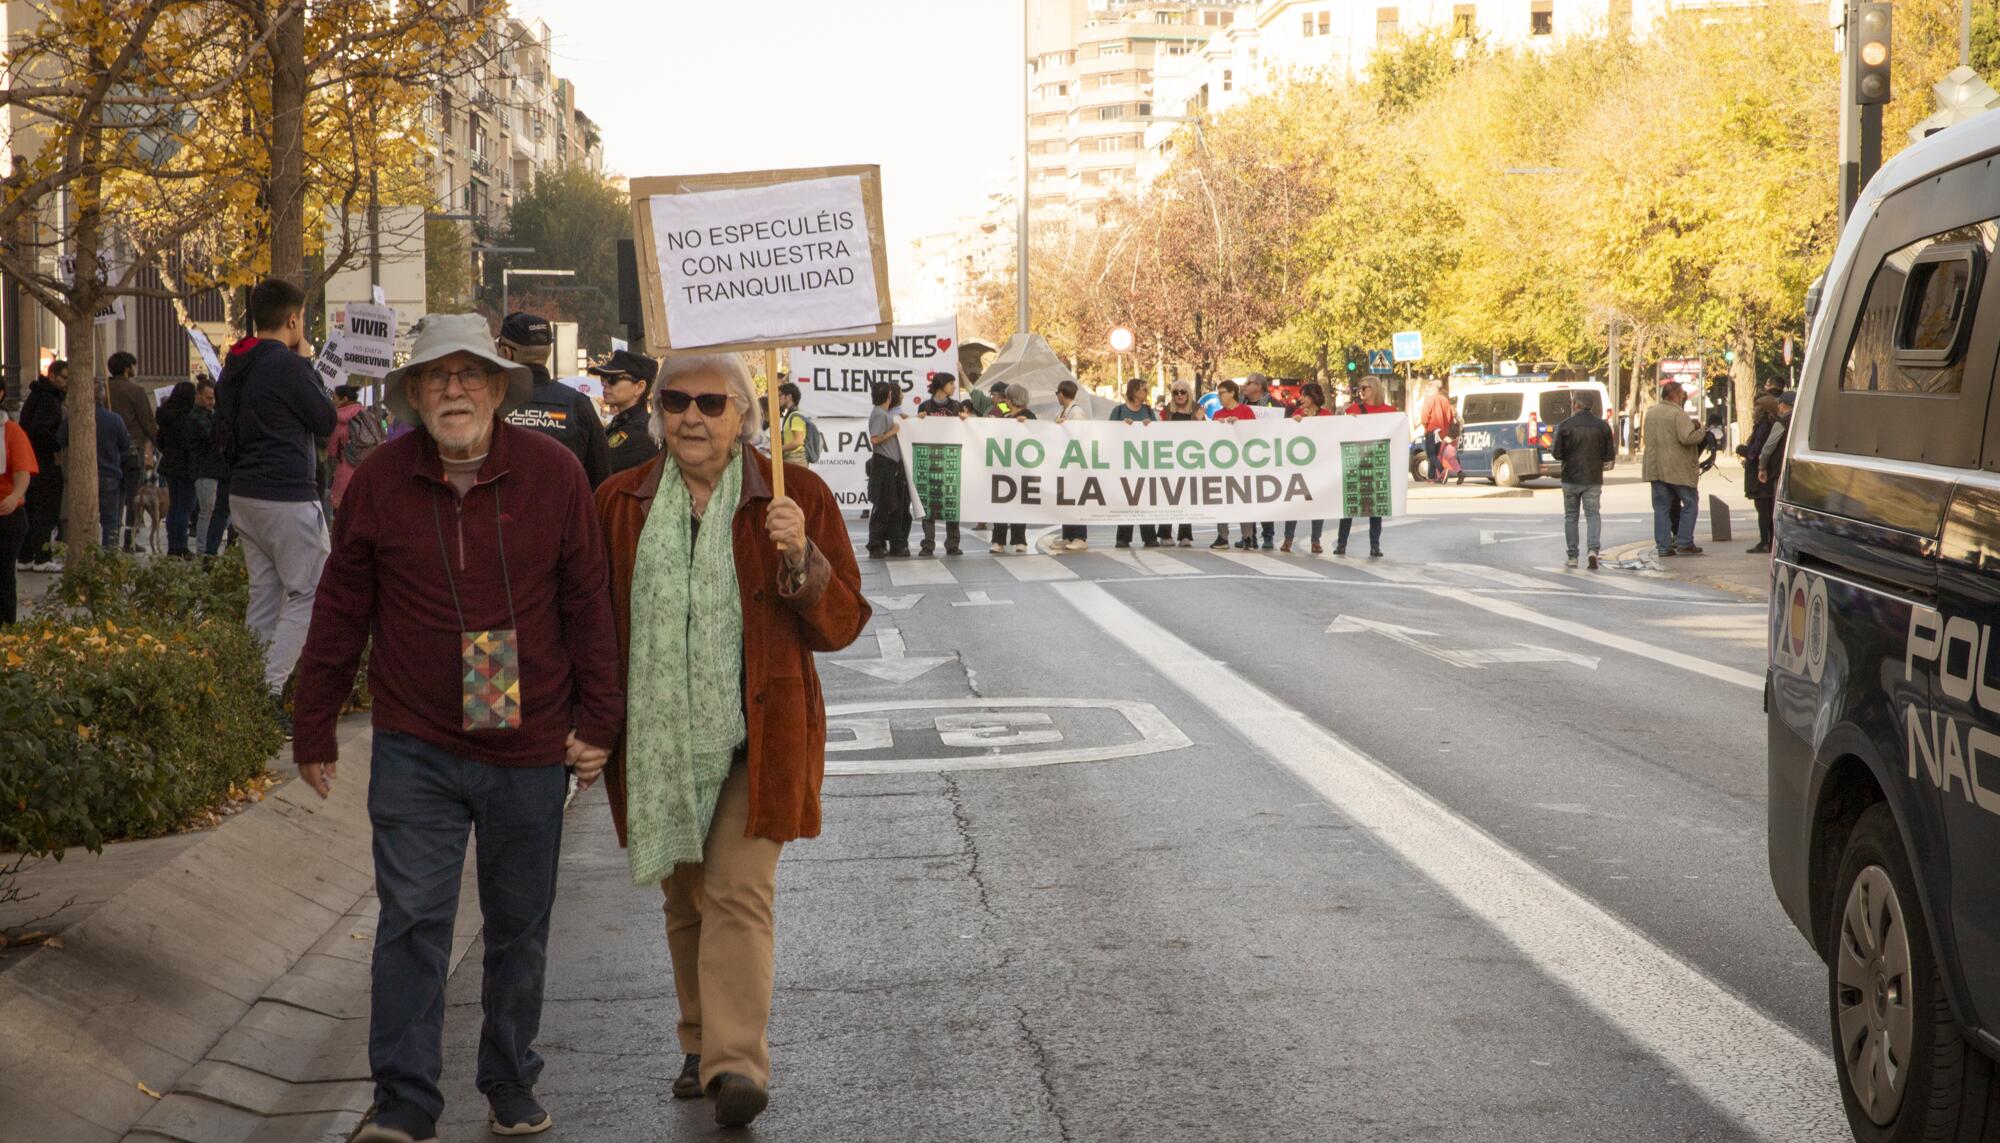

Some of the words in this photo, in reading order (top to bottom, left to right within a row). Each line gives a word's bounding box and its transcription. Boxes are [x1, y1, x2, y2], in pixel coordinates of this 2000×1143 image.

[667, 229, 702, 251] NO
[709, 210, 854, 246] ESPECULÉIS
[681, 253, 733, 277] CON
[740, 239, 850, 270] NUESTRA
[682, 266, 854, 304] TRANQUILIDAD
[351, 317, 388, 338] VIVIR
[344, 353, 390, 368] SOBREVIVIR
[364, 345, 382, 355] para
[317, 361, 338, 379] PAGAR
[507, 408, 550, 419] LICIA
[985, 437, 1046, 469] NO
[1059, 438, 1110, 470] AL
[1122, 435, 1317, 470] NEGOCIO
[990, 474, 1042, 505] DE
[1055, 475, 1107, 507] LA
[1120, 473, 1313, 507] VIVIENDA
